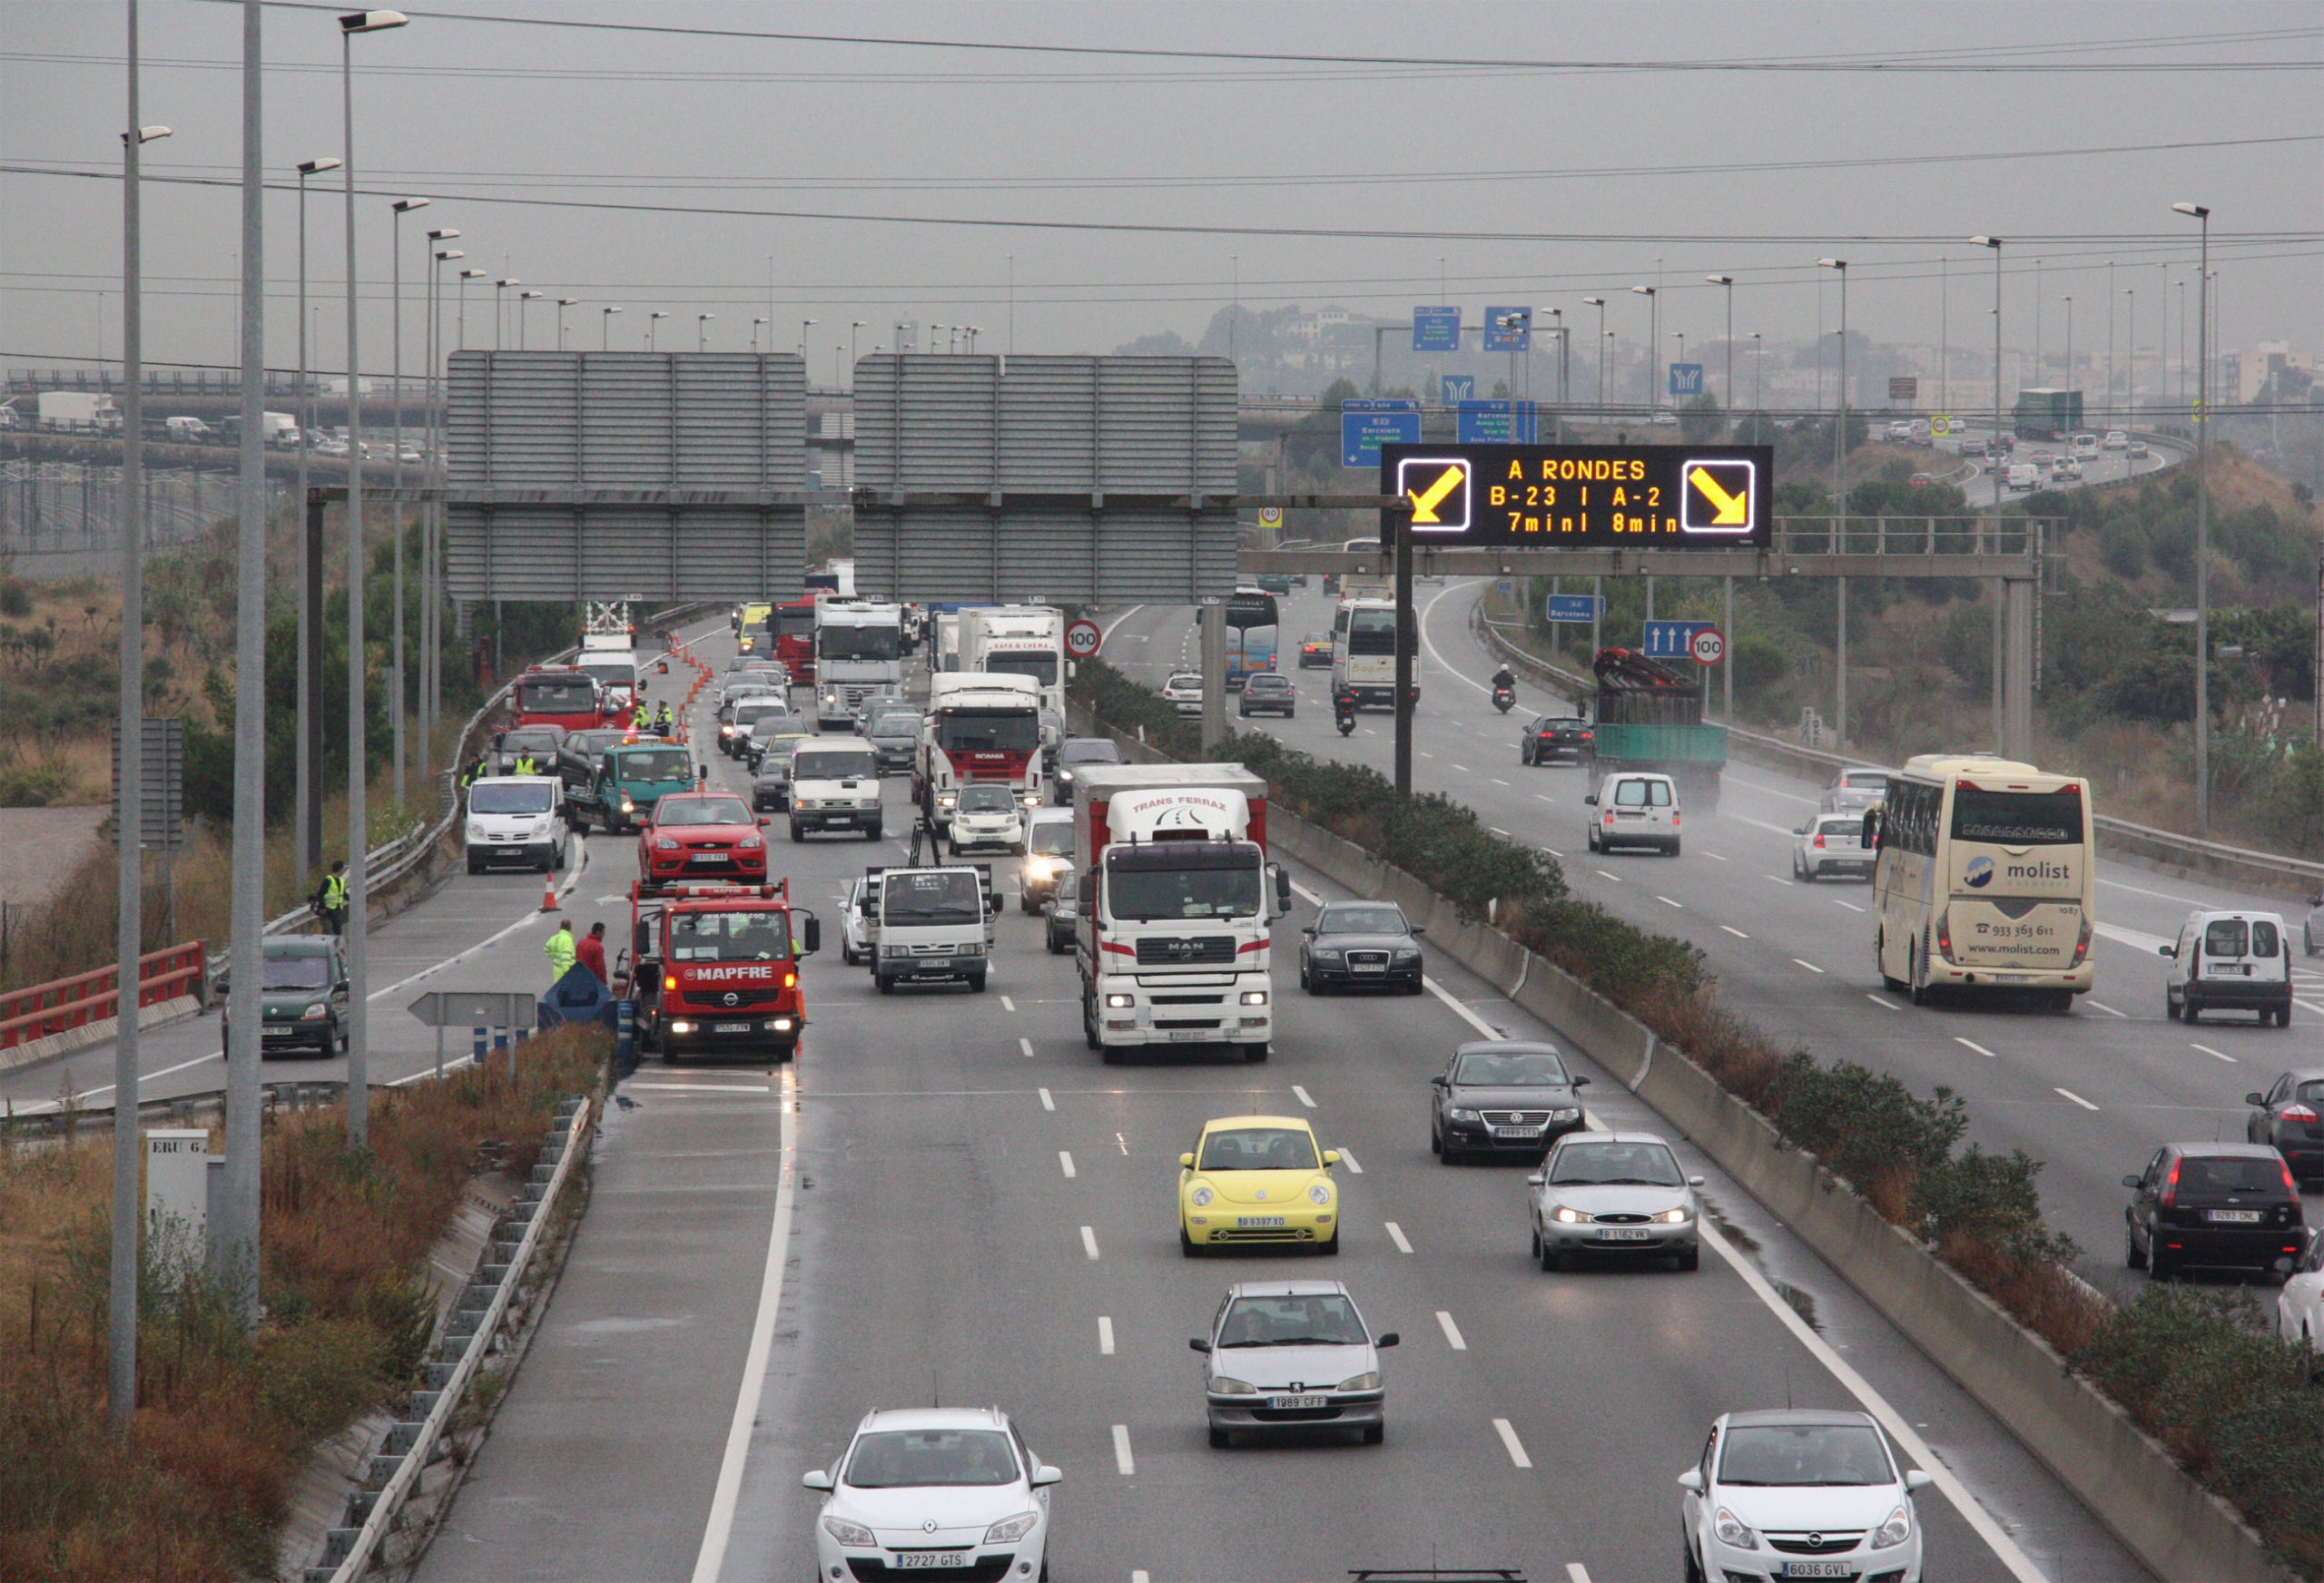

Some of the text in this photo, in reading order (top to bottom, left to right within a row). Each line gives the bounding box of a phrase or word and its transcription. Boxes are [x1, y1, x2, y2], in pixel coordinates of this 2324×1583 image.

[1508, 460, 1646, 480] A RONDES
[1490, 487, 1556, 506] B-23
[1612, 487, 1660, 506] A-2
[1508, 512, 1573, 532] 7min
[1612, 512, 1678, 532] 8min
[1550, 609, 1590, 618] Barcelona
[1069, 633, 1096, 645] 100
[1695, 640, 1722, 654] 100
[1132, 796, 1227, 813] TRANS FERRAZ
[2007, 860, 2070, 880] molist
[2059, 907, 2079, 917] 1087
[1993, 924, 2054, 938] 933 363 611
[1968, 944, 2061, 956] www.molist.com
[696, 966, 773, 980] MAPFRE
[153, 1141, 182, 1154] ERU
[2214, 1211, 2236, 1220] 9283
[1275, 1396, 1324, 1408] 1989 CFF
[906, 1555, 961, 1567] 2727 GTS
[1789, 1564, 1847, 1576] 6036 GVL
